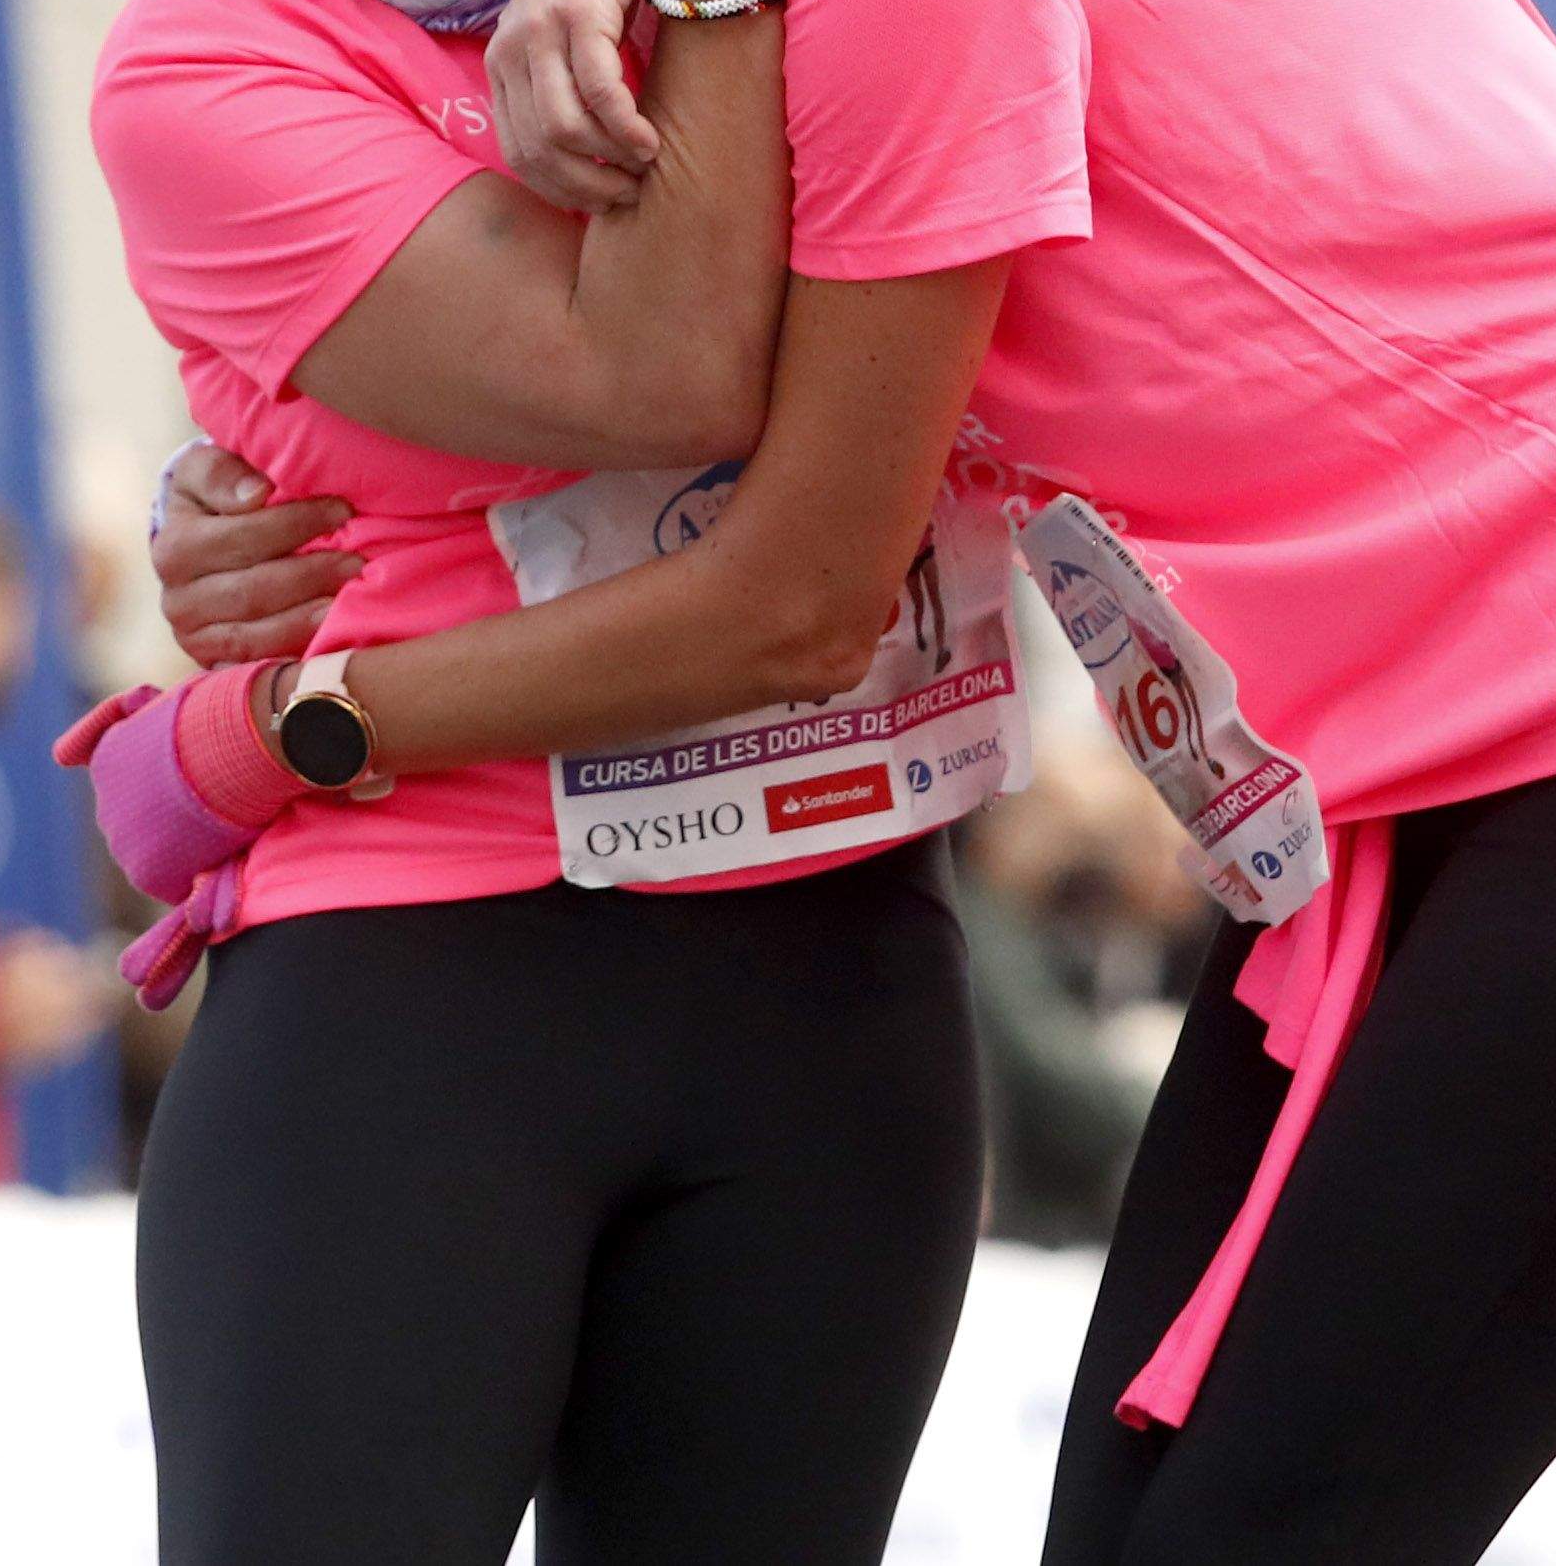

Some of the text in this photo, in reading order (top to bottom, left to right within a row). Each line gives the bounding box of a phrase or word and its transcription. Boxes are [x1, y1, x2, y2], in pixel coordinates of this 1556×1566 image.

[578, 665, 1007, 788] CURSA DE LES DONES DE BARCELONA
[938, 736, 1002, 777] ZURICH
[801, 783, 875, 812] Santander
[585, 801, 744, 858] OYSHO
